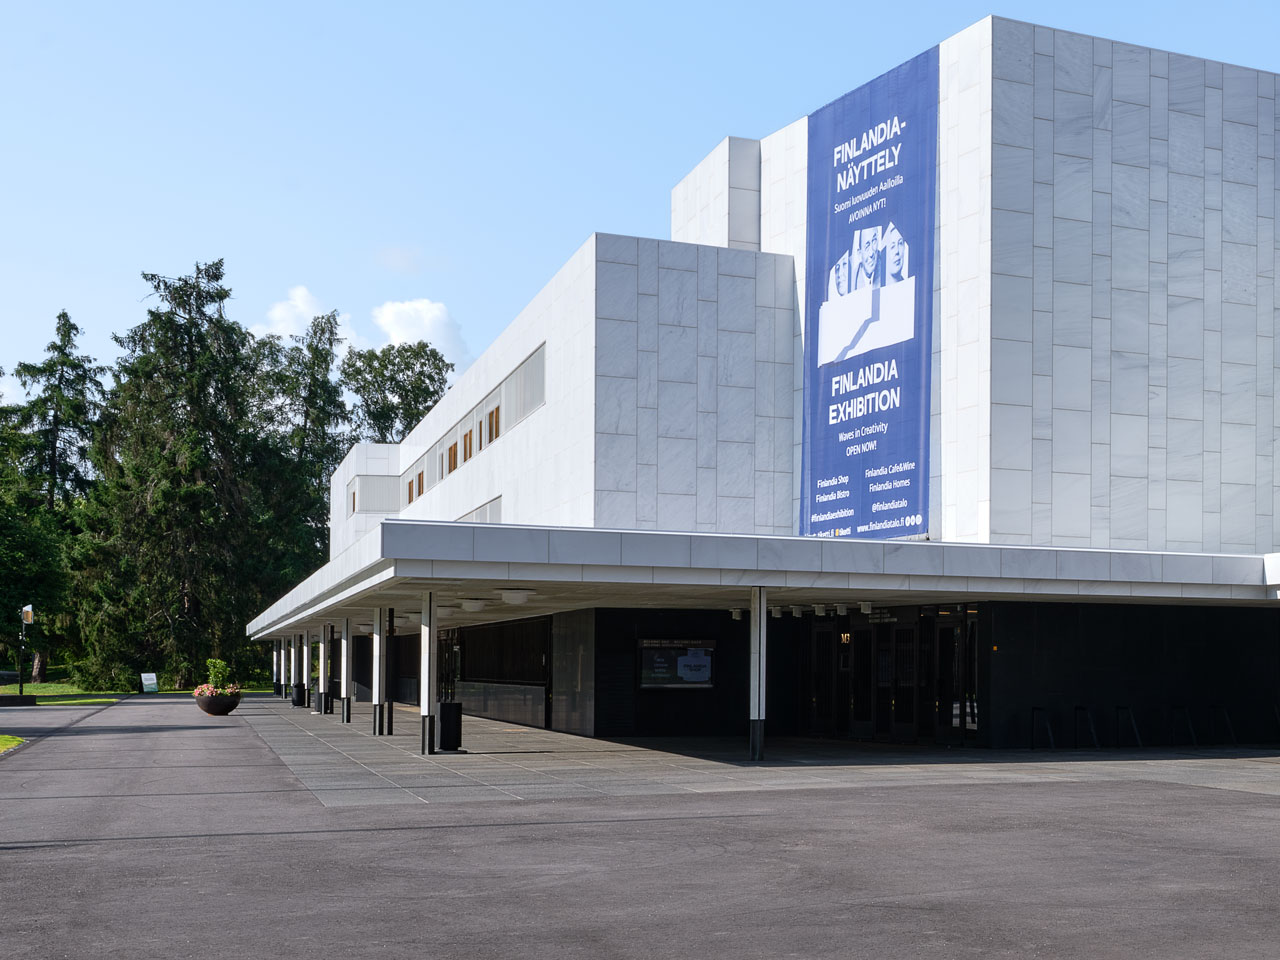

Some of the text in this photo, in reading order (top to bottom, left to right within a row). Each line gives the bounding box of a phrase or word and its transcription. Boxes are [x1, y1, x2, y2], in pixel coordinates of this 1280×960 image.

[833, 115, 906, 168] FINLANDIA-
[837, 142, 902, 193] NÄYTTELY
[834, 198, 852, 214] Suomi
[850, 186, 879, 208] luovuuden
[848, 197, 887, 225] AVOINNA NYT!
[831, 358, 899, 397] FINLANDIA
[828, 386, 901, 425] EXHIBITION
[838, 421, 889, 442] Waves in Creativity
[846, 440, 877, 457] OPEN NOW!
[817, 475, 849, 488] Finlandia Shop
[865, 466, 888, 478] Finlandia
[869, 478, 911, 493] Finlandia Homes
[815, 490, 850, 503] Finlandia Bistro
[871, 498, 908, 513] @finlandiatalo
[856, 517, 905, 533] www.finlandiatalo.fi
